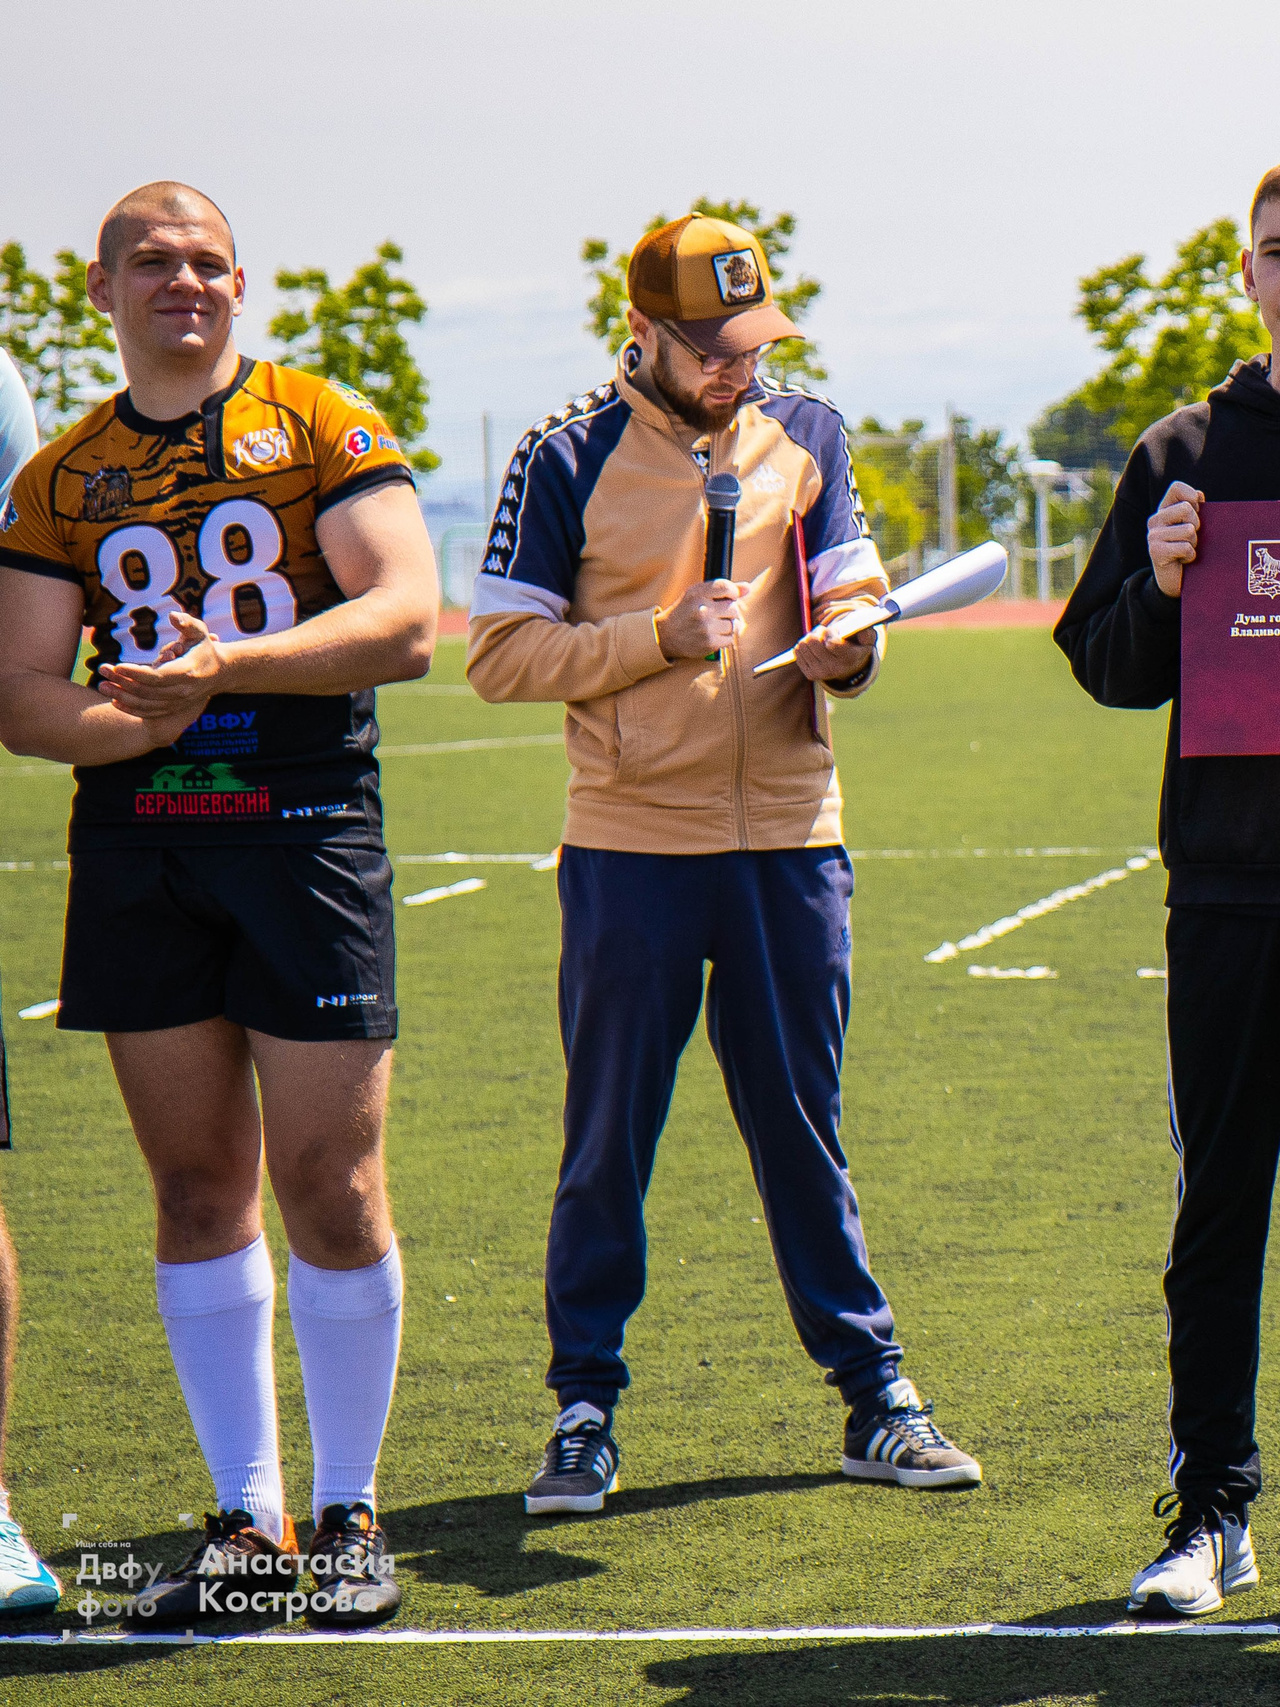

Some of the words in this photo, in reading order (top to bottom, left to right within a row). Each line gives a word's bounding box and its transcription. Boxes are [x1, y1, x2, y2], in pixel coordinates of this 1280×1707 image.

[98, 499, 297, 665] 88
[1234, 613, 1266, 625] Дума
[134, 785, 271, 815] СЕРЫШЕВСКИЙ
[349, 993, 379, 1002] SPORT
